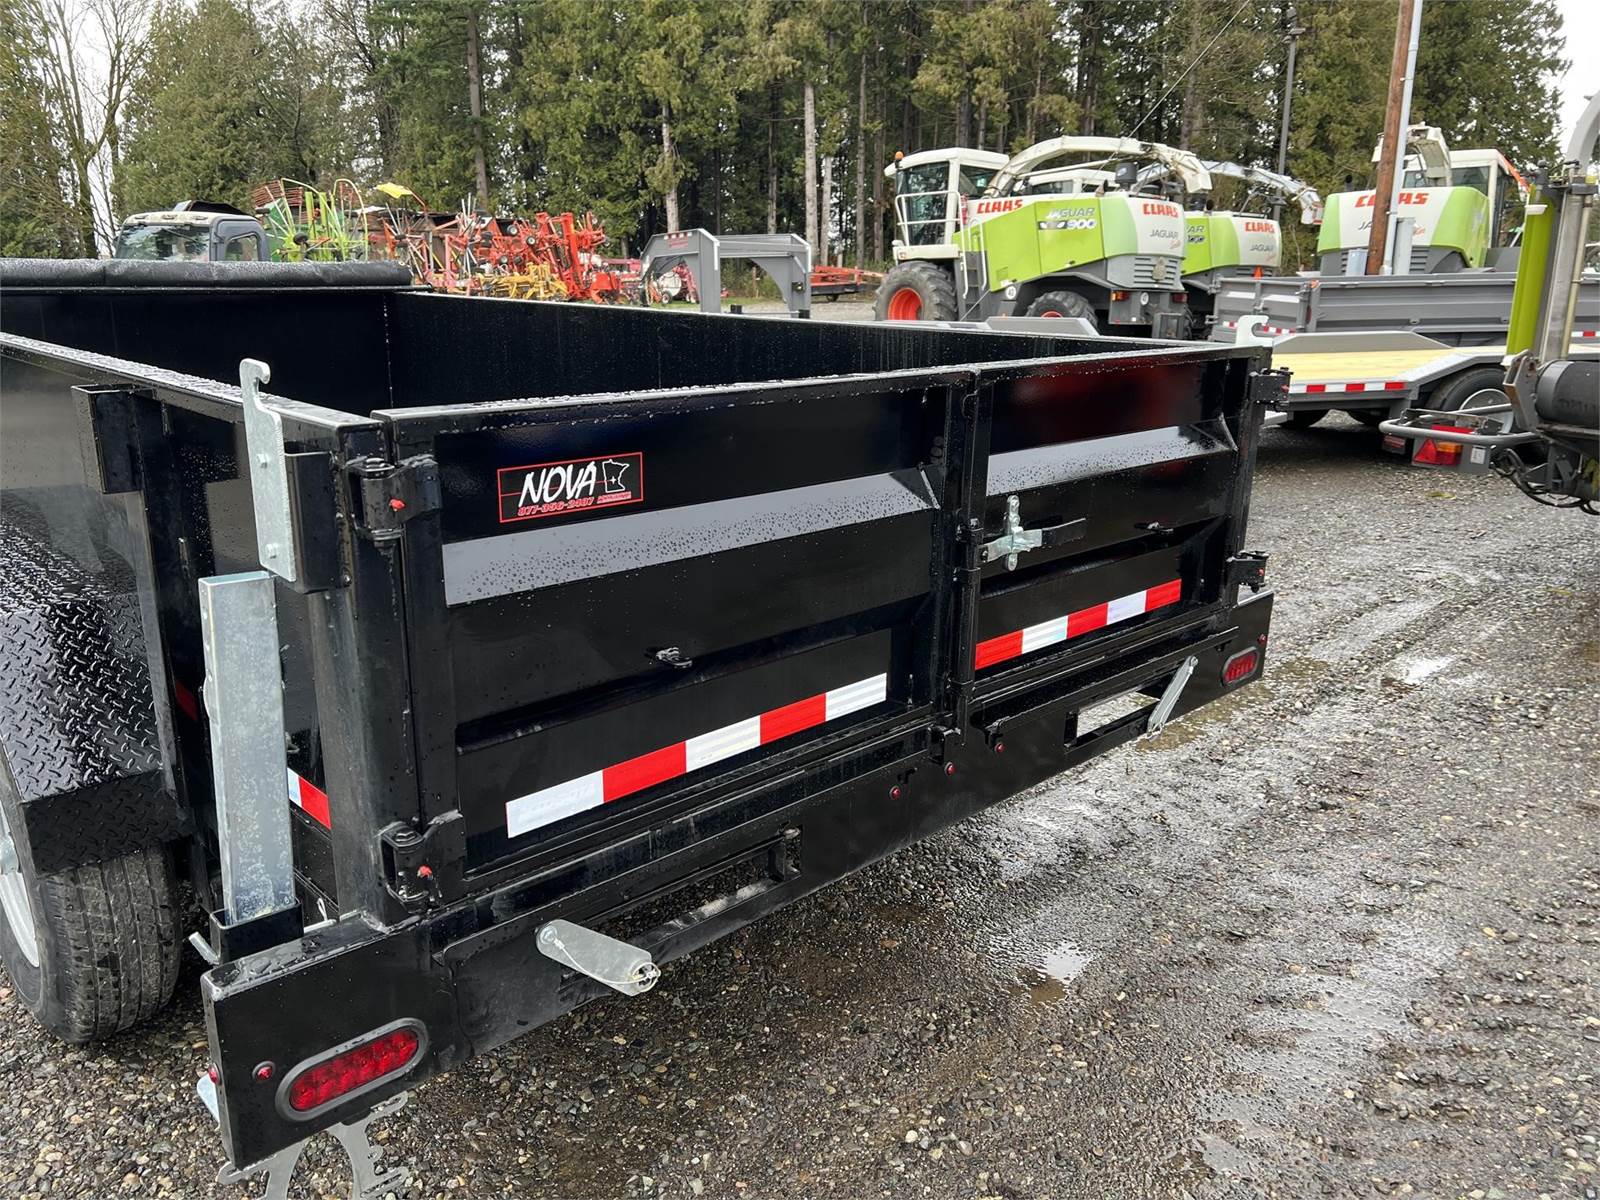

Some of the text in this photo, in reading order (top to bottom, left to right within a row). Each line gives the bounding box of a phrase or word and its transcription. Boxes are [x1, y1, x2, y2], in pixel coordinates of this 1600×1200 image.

[977, 199, 1023, 214] CLAAS
[1355, 192, 1429, 208] CLAS
[1143, 203, 1179, 218] CLAAS
[1150, 229, 1180, 239] JAGUAR
[1245, 222, 1276, 233] CLAAS
[518, 461, 597, 507] NOVA
